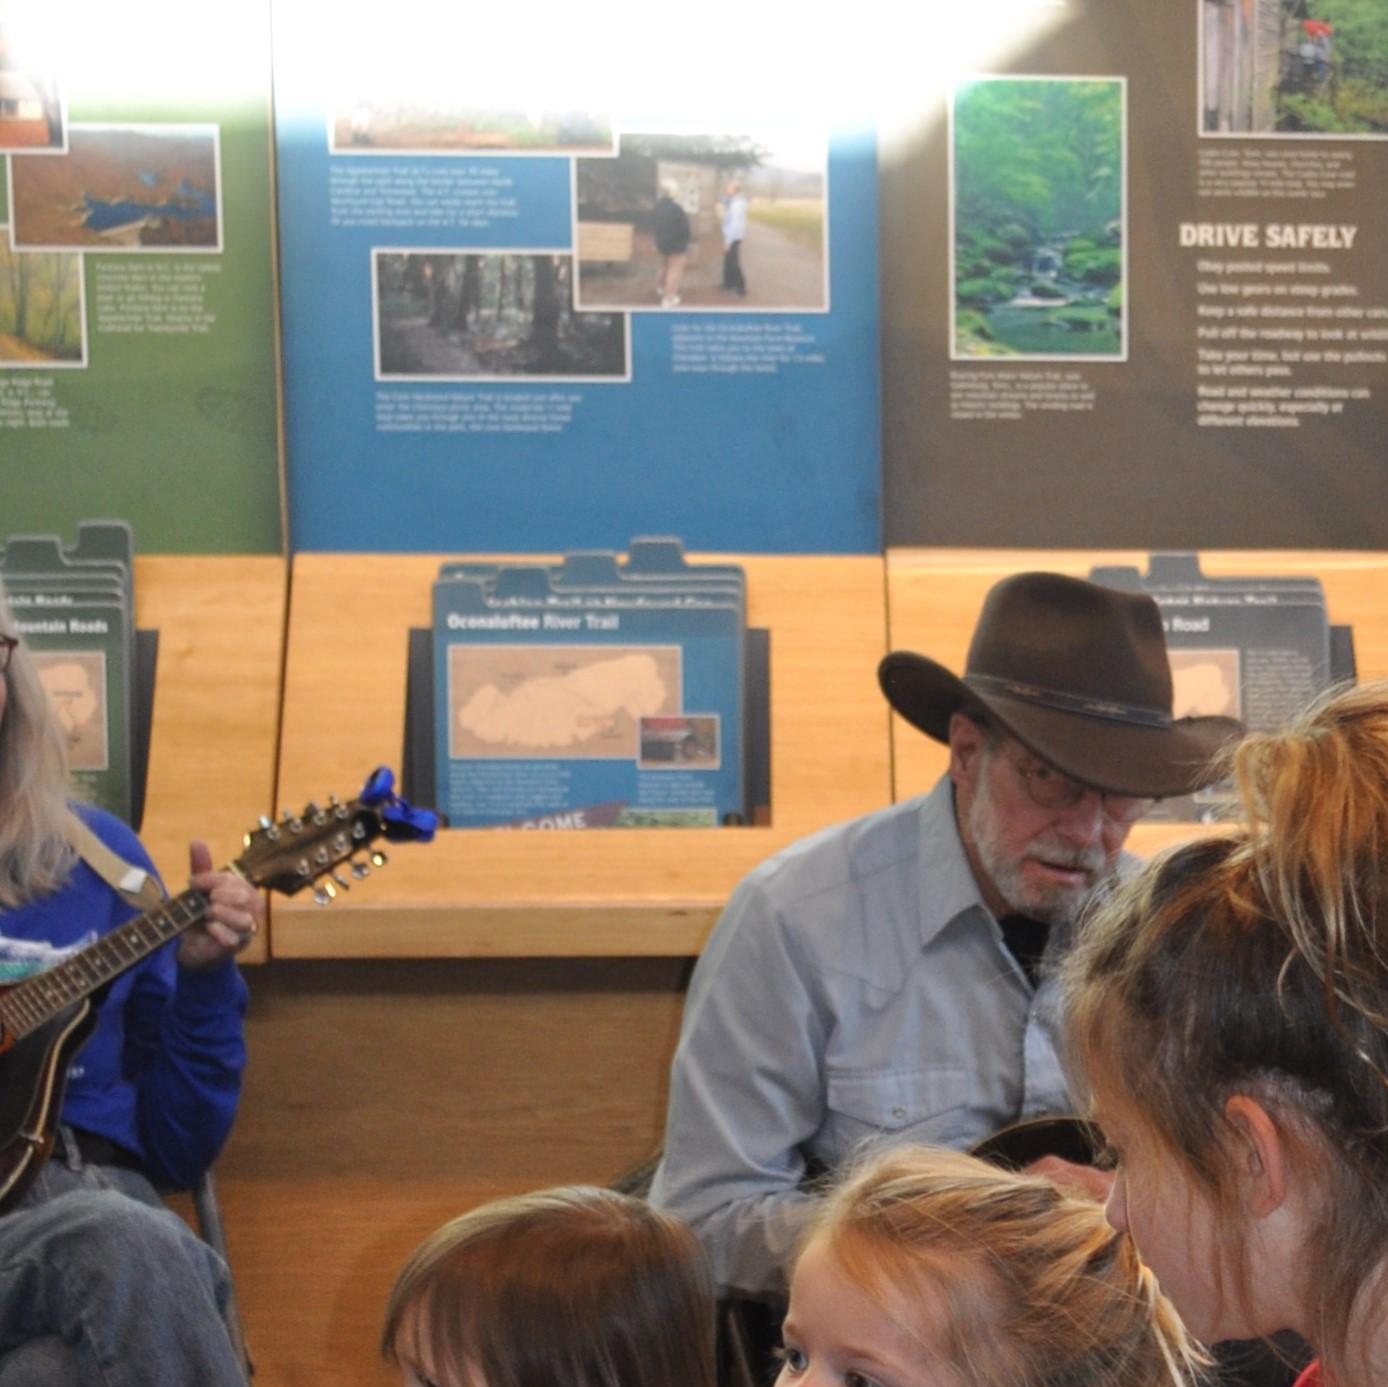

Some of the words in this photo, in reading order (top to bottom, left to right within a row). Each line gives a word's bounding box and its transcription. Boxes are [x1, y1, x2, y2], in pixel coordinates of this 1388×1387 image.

[1179, 224, 1259, 248] DRIVE
[1265, 224, 1358, 248] SAFELY
[15, 618, 67, 634] ountain
[69, 618, 108, 634] Roads
[447, 613, 539, 630] Oconaluftee
[543, 614, 581, 630] River
[584, 614, 619, 630] Trail
[1172, 616, 1210, 632] Road
